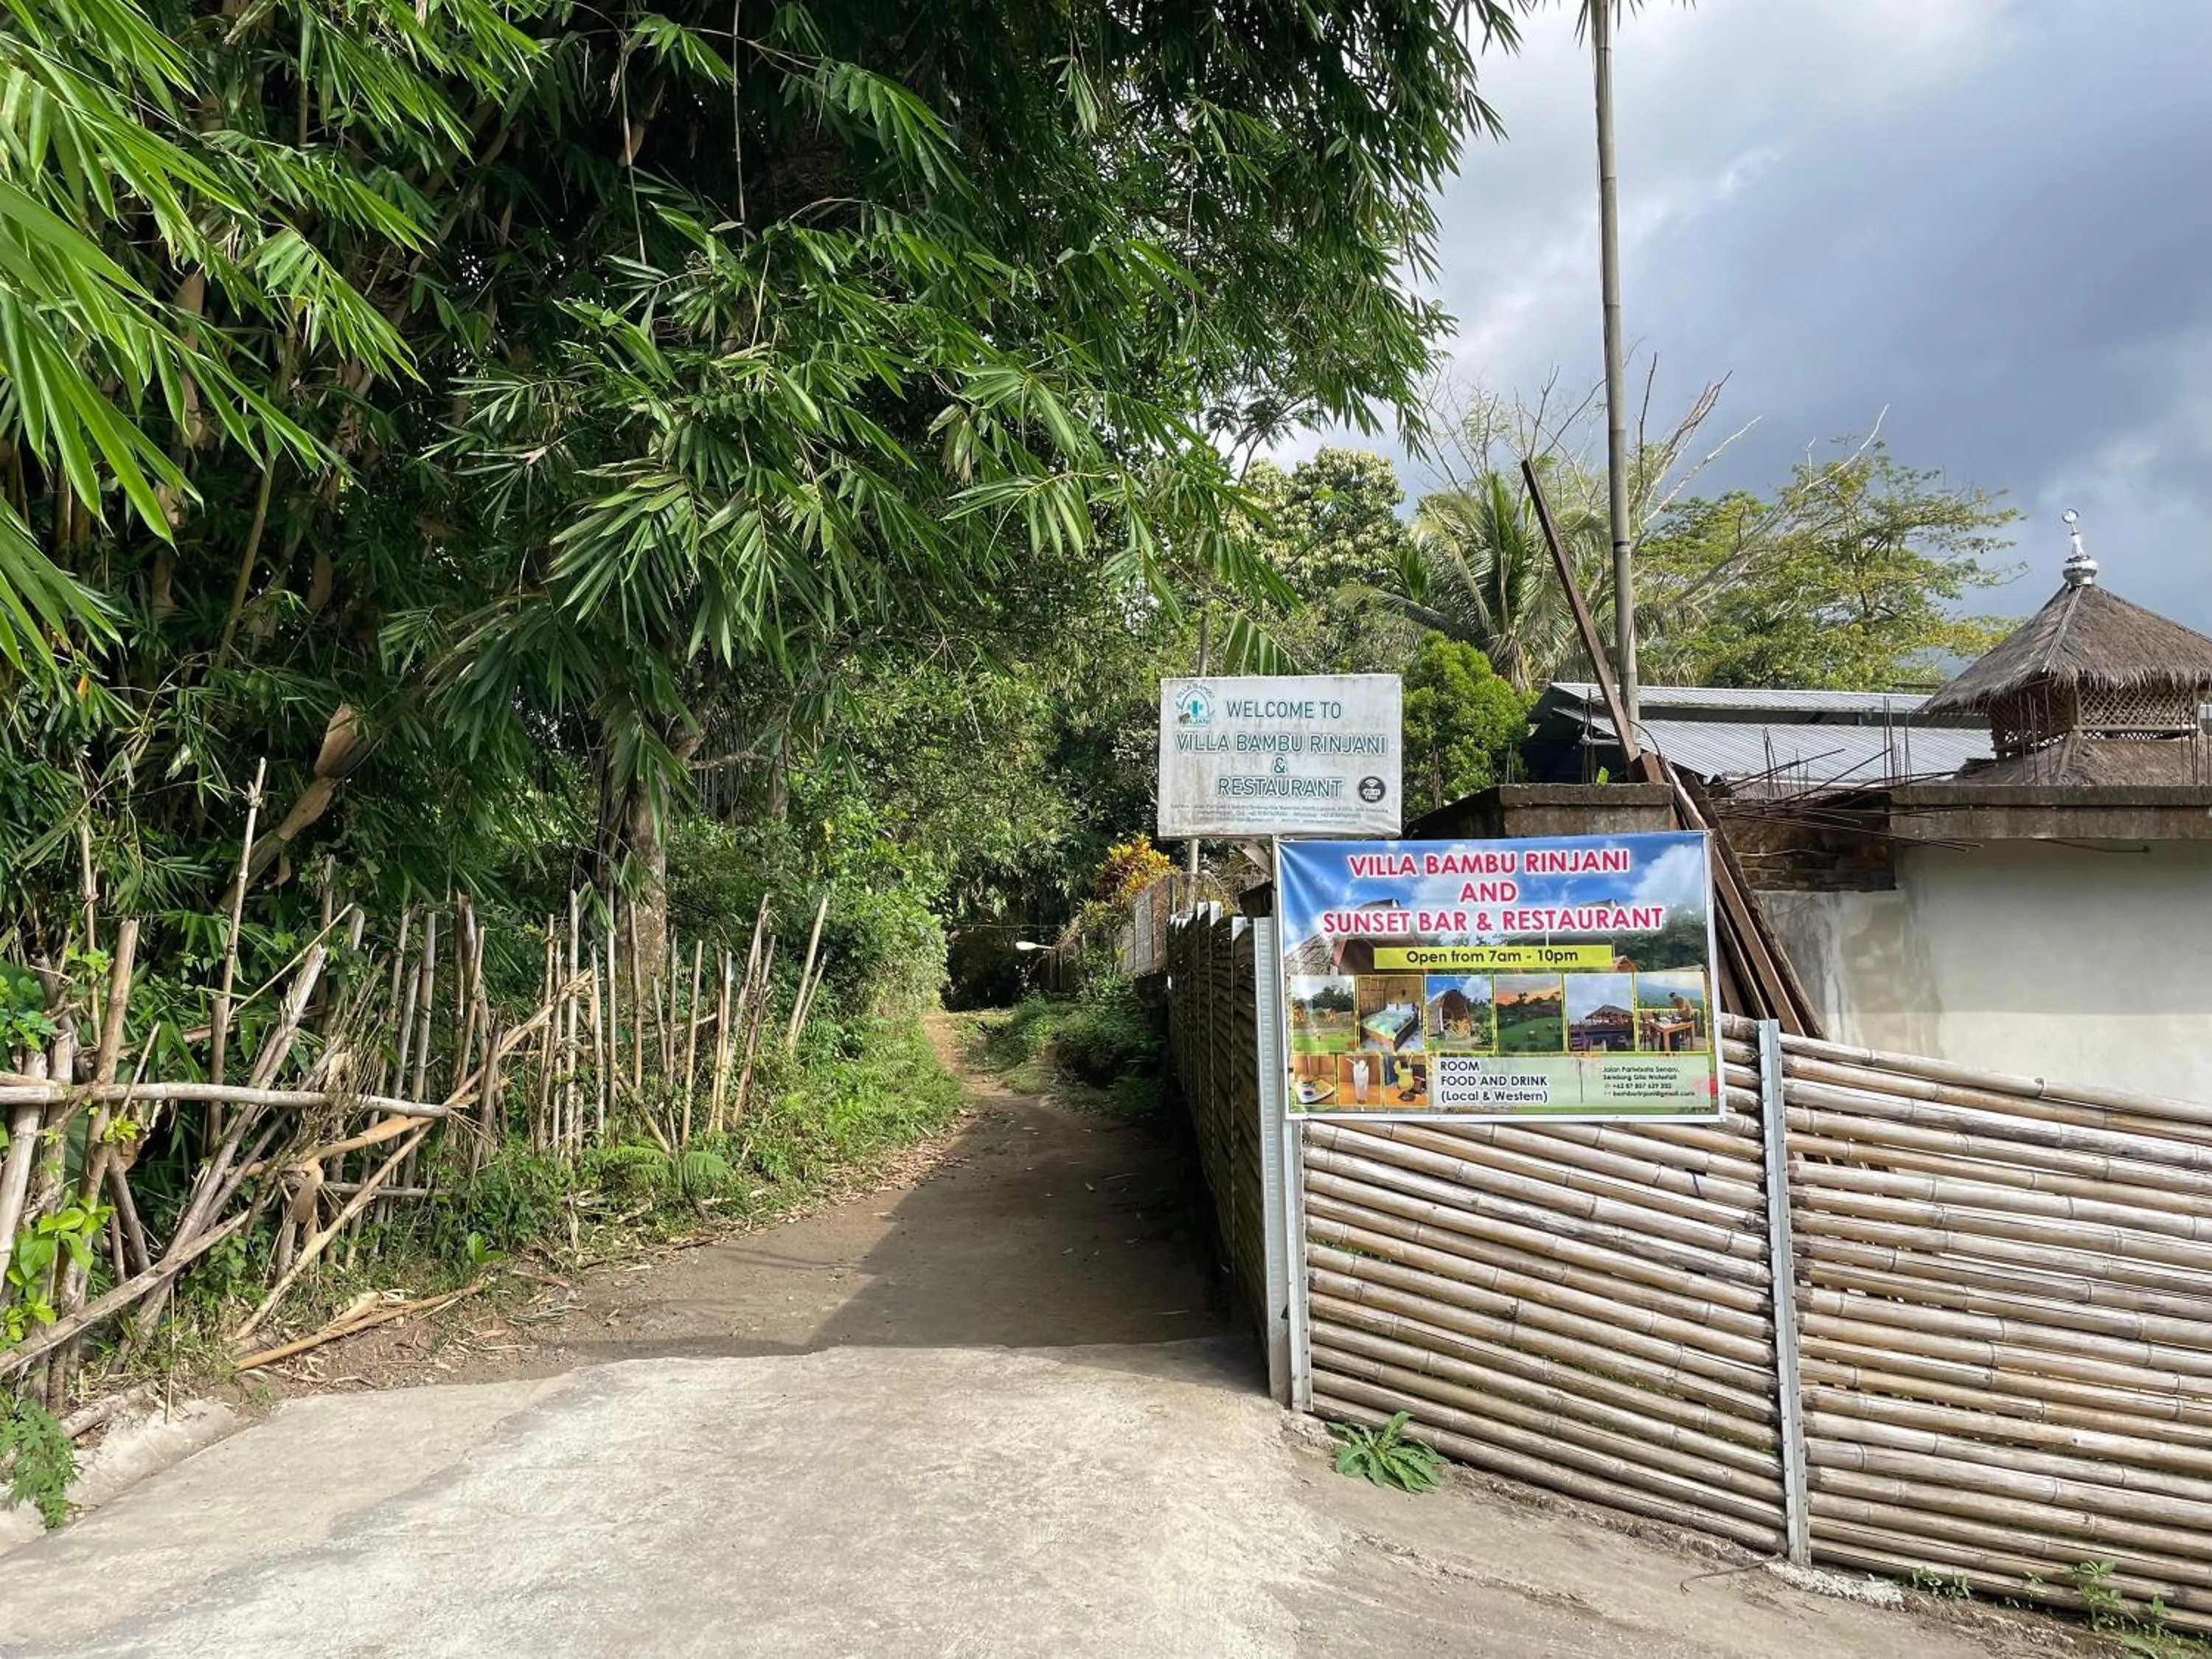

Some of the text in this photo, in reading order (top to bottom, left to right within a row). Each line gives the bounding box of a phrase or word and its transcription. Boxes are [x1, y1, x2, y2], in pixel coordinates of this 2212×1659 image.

[1226, 701, 1342, 719] WELCOME TO
[1177, 734, 1385, 754] VILLA BAMBU RINJANI
[1273, 757, 1286, 773] &
[1219, 778, 1343, 797] RESTAURANT
[1349, 850, 1628, 876] VILLA BAMBU RINJANI
[1460, 882, 1517, 902] AND
[1324, 908, 1663, 933] SUNSET BAR & RESTAURANT
[1407, 950, 1447, 964] Open
[1451, 950, 1484, 961] from
[1489, 950, 1521, 961] 7am
[1538, 950, 1579, 964] 10pm
[1440, 1061, 1480, 1071] ROOM
[1441, 1076, 1548, 1086] FOOD AND DRINK
[1441, 1091, 1548, 1103] (Local & Western)
